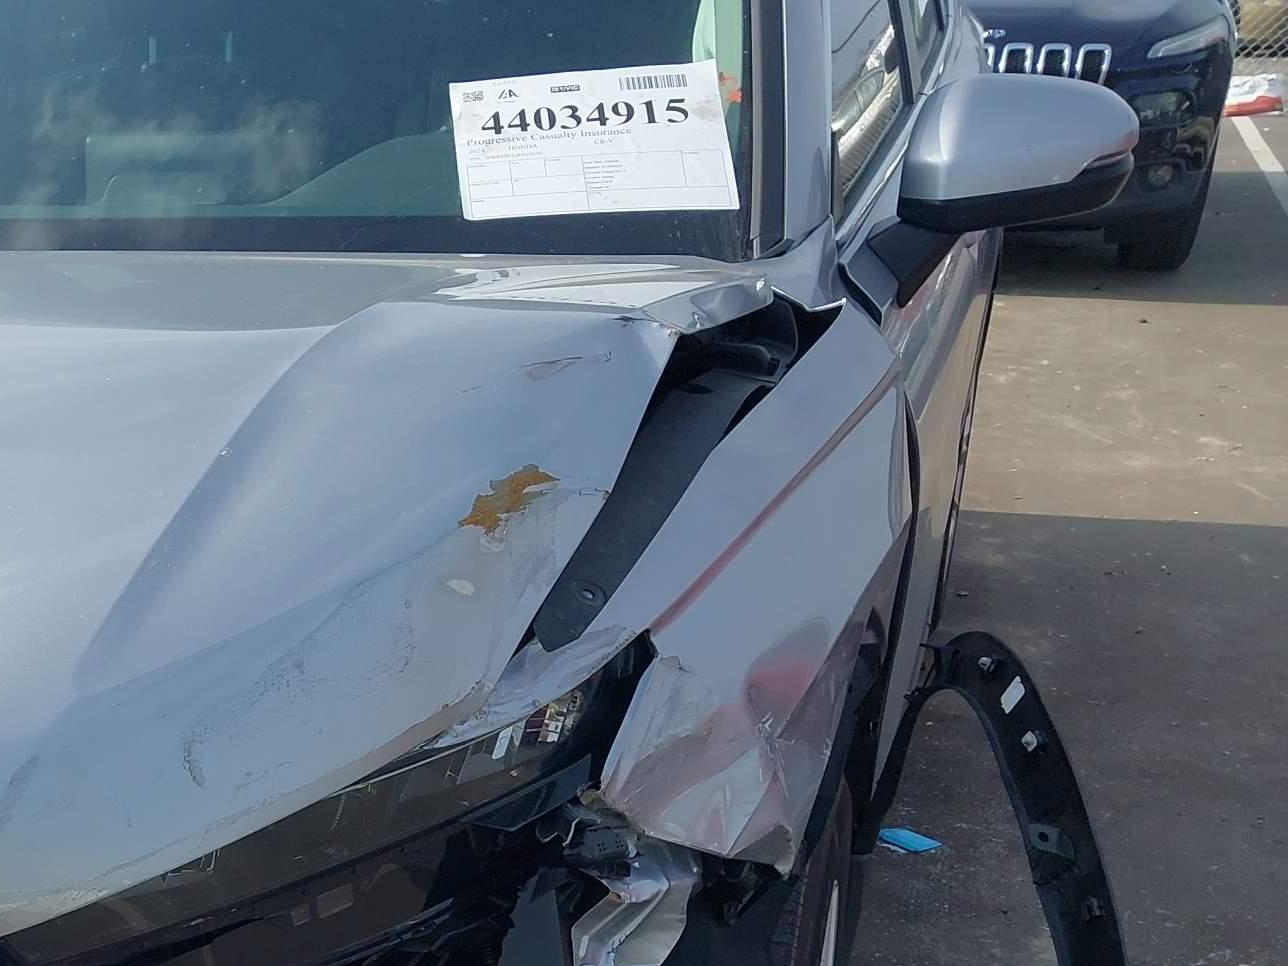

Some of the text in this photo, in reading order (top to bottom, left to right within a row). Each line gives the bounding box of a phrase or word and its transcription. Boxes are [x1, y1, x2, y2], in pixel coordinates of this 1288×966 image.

[481, 98, 689, 135] 44034915
[467, 127, 632, 146] Progressive Casualty Insurance
